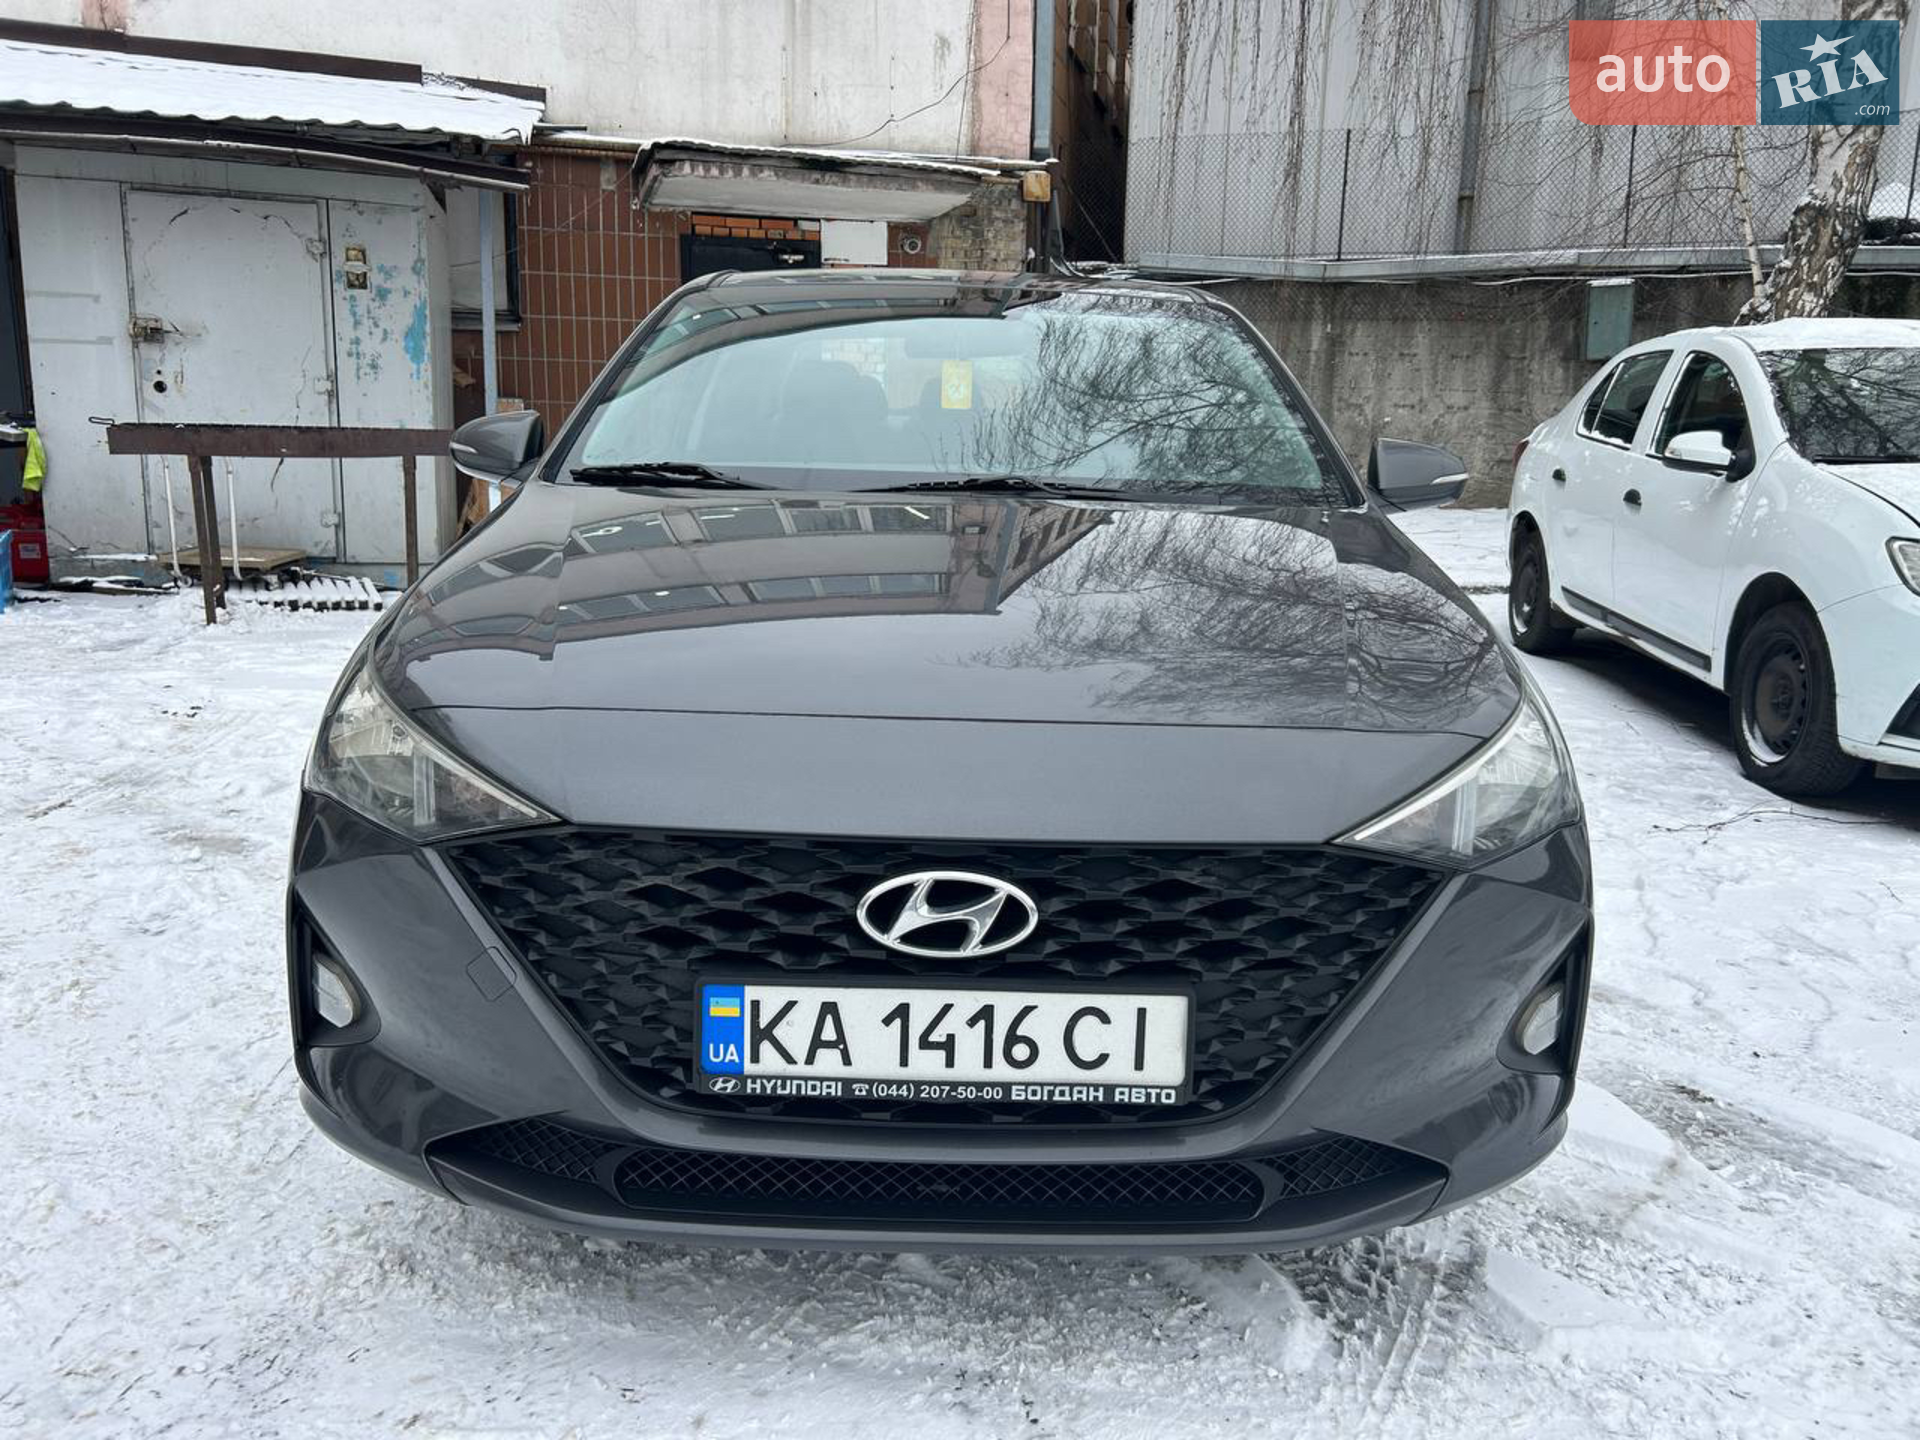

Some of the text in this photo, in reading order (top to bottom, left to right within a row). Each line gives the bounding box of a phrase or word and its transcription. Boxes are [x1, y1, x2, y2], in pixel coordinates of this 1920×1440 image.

[750, 1000, 1147, 1071] KA 1416 CI
[709, 1043, 740, 1063] UA
[746, 1079, 1176, 1104] HYUNDAI (044) 207-50-00 БОГДАН АВТО
